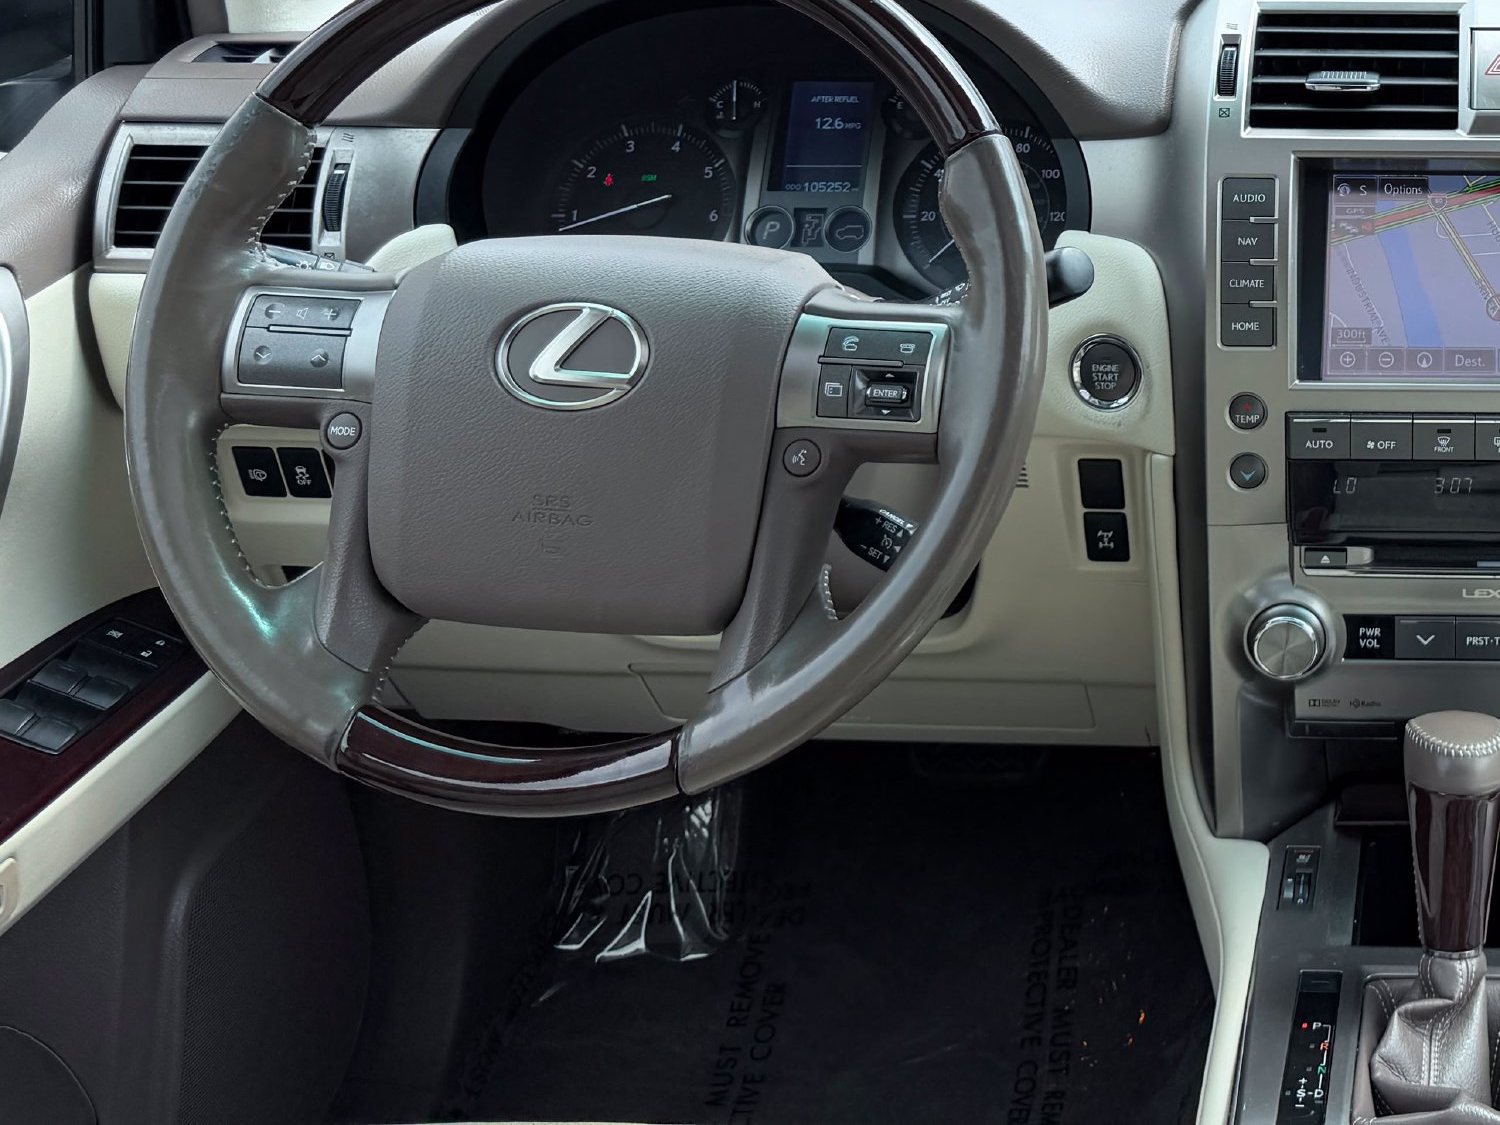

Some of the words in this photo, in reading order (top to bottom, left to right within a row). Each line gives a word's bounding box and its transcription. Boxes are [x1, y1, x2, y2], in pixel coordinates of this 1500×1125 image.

[810, 95, 834, 104] AFTER
[834, 95, 860, 104] REFUEL
[815, 117, 844, 130] 12.6
[625, 140, 635, 153] 3
[671, 140, 681, 153] 4
[1015, 142, 1031, 153] 80
[586, 166, 597, 178] 2
[703, 166, 713, 179] 5
[1041, 169, 1061, 180] 100
[785, 183, 801, 191] ODO
[803, 181, 851, 194] 105252
[1359, 185, 1367, 196] S
[1384, 183, 1423, 196] Options
[1232, 193, 1266, 203] AUDIO
[571, 209, 578, 221] 1
[709, 209, 719, 222] 6
[920, 211, 936, 222] 20
[1237, 237, 1258, 246] NAV
[1229, 279, 1265, 288] CLIMATE
[1345, 268, 1380, 325] INDUSTRIAL
[1376, 325, 1391, 345] AVE
[1231, 322, 1260, 331] HOME
[1336, 330, 1366, 339] 300ft
[1455, 354, 1486, 368] Dest.
[1091, 363, 1120, 373] ENGINE
[1092, 373, 1119, 382] START
[1094, 381, 1117, 391] STOP
[872, 387, 899, 399] ENTER
[1235, 414, 1260, 424] TEMP
[330, 426, 356, 436] MODE
[1305, 440, 1334, 449] AUTO
[1376, 440, 1396, 450] OFF
[1434, 446, 1455, 454] FRONT
[532, 494, 571, 508] SRS
[511, 510, 594, 526] AIRBAG
[881, 520, 898, 534] RES
[867, 546, 884, 560] SET
[1359, 627, 1381, 638] PWR
[1359, 638, 1380, 648] VOL
[1055, 903, 1084, 991] DEALER
[1019, 909, 1055, 1052] PROTECTIVE
[703, 1042, 743, 1108] MUST
[726, 933, 772, 1028] REMOVE
[750, 981, 788, 1063] COVER
[1312, 1021, 1322, 1030] P
[1048, 1007, 1074, 1078] MUST
[1320, 1042, 1330, 1051] R
[1317, 1065, 1327, 1075] N
